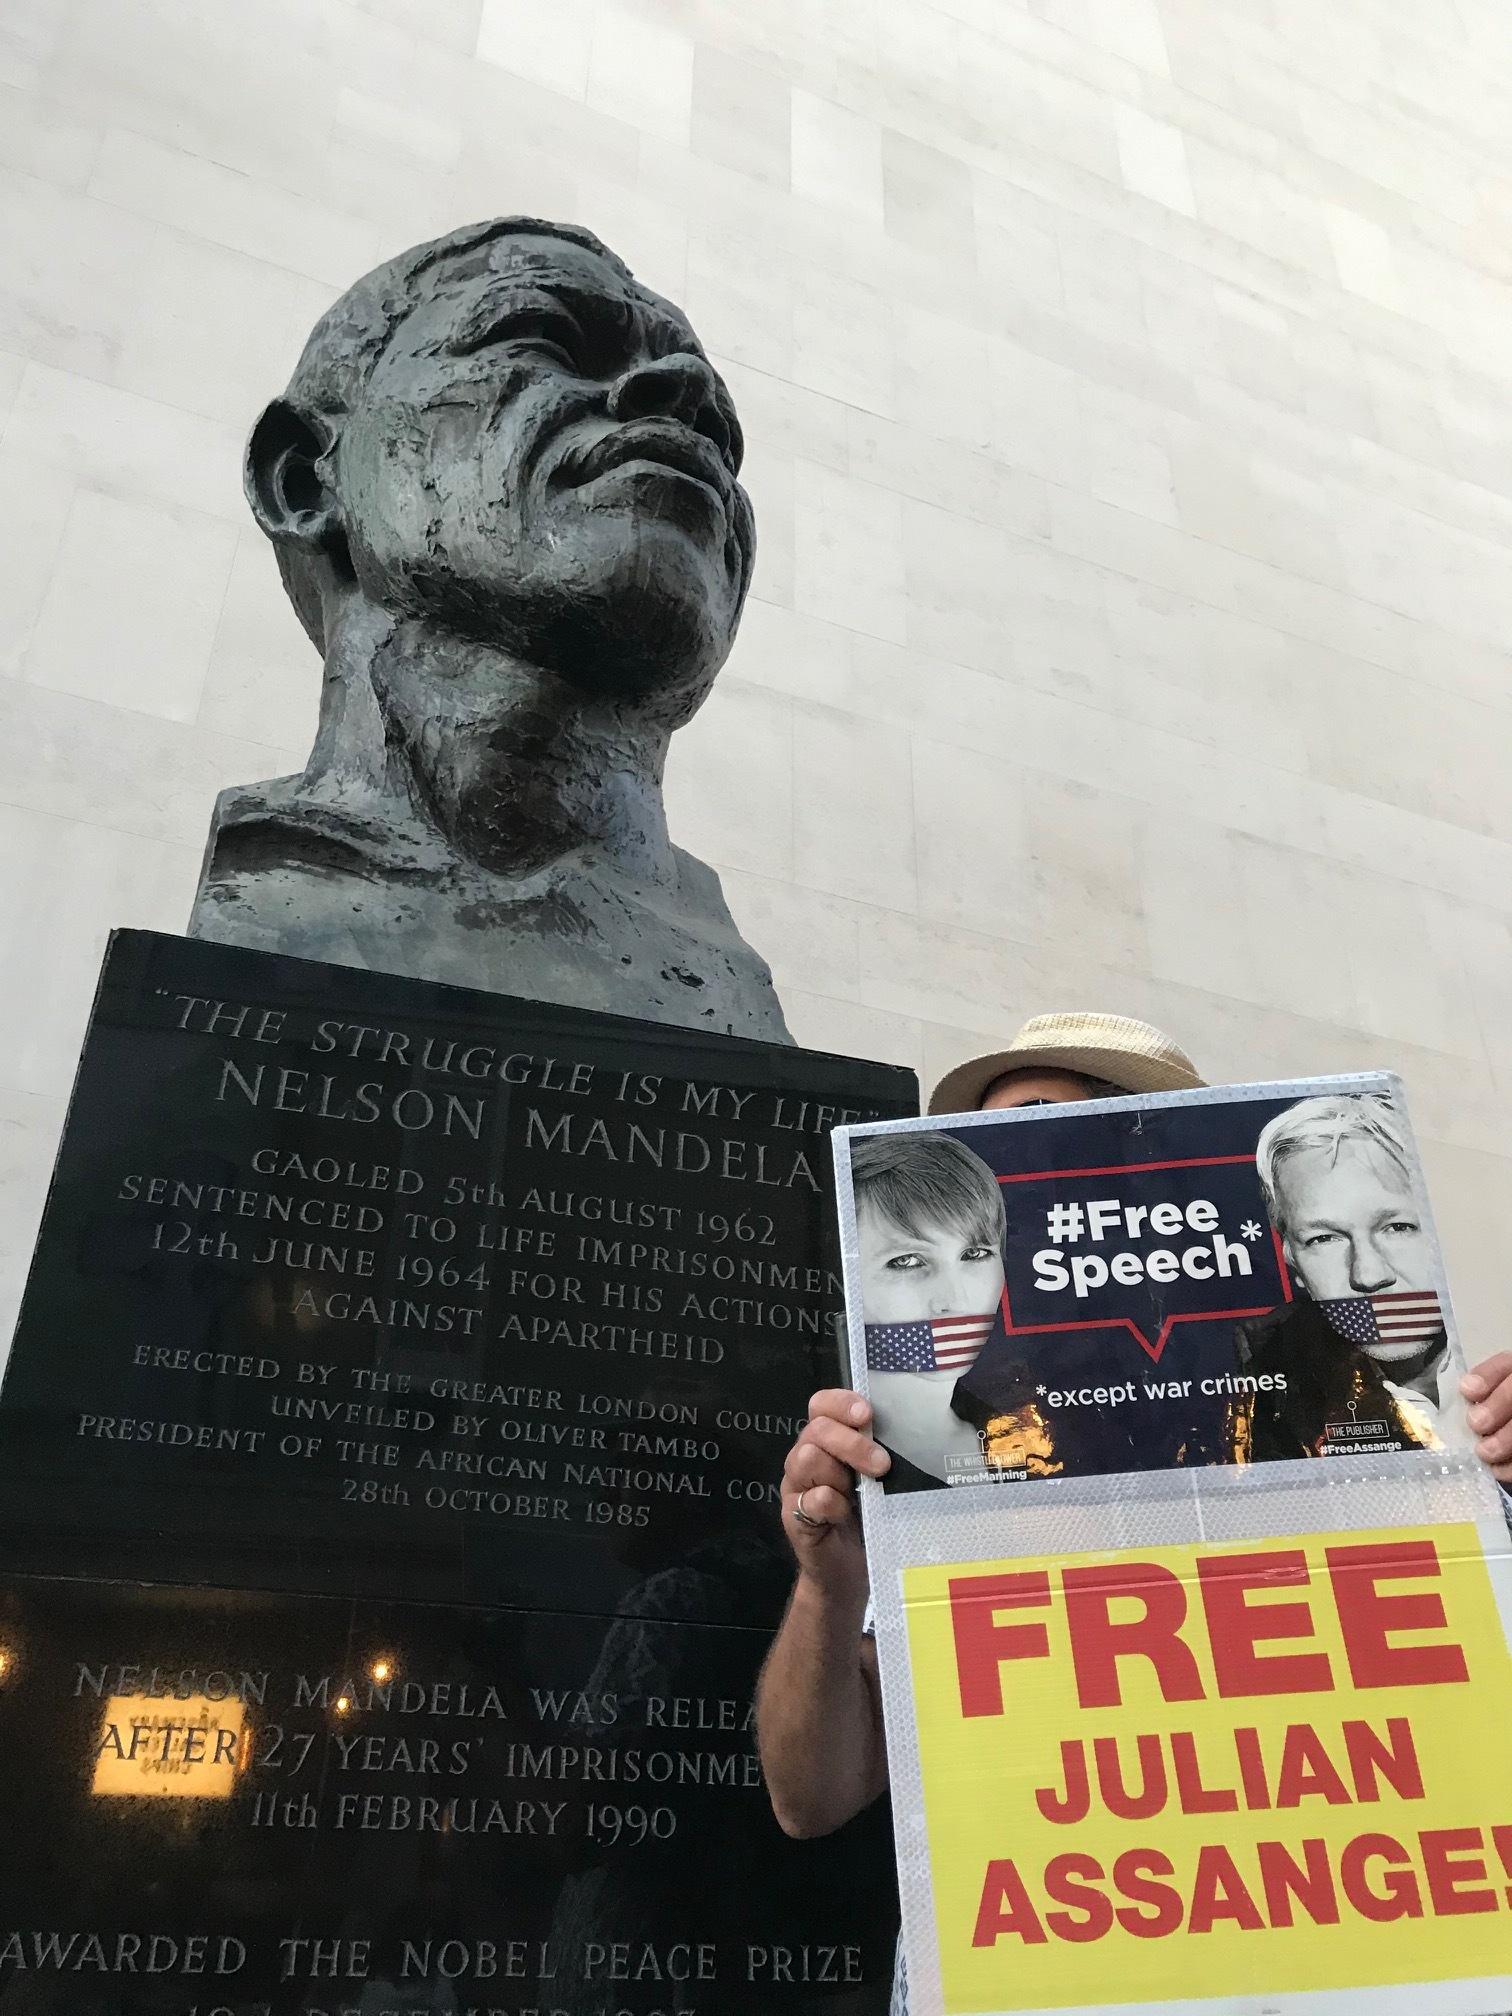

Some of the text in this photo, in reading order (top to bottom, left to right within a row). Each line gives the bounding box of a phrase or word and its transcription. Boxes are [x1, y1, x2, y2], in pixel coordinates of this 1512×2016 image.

[310, 1020, 595, 1096] STRUGGLE
[615, 1071, 663, 1106] IS
[680, 1081, 758, 1120] MY
[214, 1057, 823, 1193] NELSON MANDELA
[117, 1174, 384, 1235] SENTENCED
[404, 1212, 457, 1244] TO
[476, 1221, 557, 1257] LIFE
[251, 1148, 777, 1247] GAOLED 5th AUGUST 1962
[1047, 1199, 1219, 1244] #Free
[151, 1221, 837, 1336] 12th JUNE 1964 FOR HIS ACTIONS
[289, 1289, 724, 1364] AGAINST APARTHEID
[132, 1344, 280, 1379] ERECTED
[297, 1363, 338, 1385] BY
[351, 1368, 412, 1394] THE
[430, 1378, 564, 1412] GREATER
[577, 1393, 698, 1426] LONDON
[1143, 1379, 1193, 1399] war
[1200, 1372, 1287, 1396] crimes
[76, 1413, 265, 1454] PRESIDENT
[279, 1434, 322, 1458] OF
[336, 1440, 400, 1467] THE
[415, 1449, 547, 1482] AFRICAN
[563, 1462, 712, 1497] NATIONAL
[271, 1395, 720, 1461] UNVEILED BY OLIVER TAMBO
[1320, 1441, 1402, 1454] #FreeAssange
[1331, 1424, 1384, 1438] THE PUBLISHER
[341, 1478, 651, 1528] 28th OCTOBER 1985
[946, 1470, 1028, 1484] #FreeManning
[948, 1540, 1470, 1718] FREE
[73, 1663, 271, 1706] NELSON
[293, 1674, 507, 1719] MANDELA
[529, 1687, 618, 1725] WAS
[101, 1723, 239, 1766] AFTER
[257, 1725, 316, 1776] 27
[1034, 1717, 1425, 1825] JULIAN
[251, 1791, 677, 1847] 11th FEBRUARY 1990
[971, 1825, 1512, 1948] ASSANGE!
[0, 1931, 863, 1983] AWARDED THE NOBEL PEACE PRIZE
